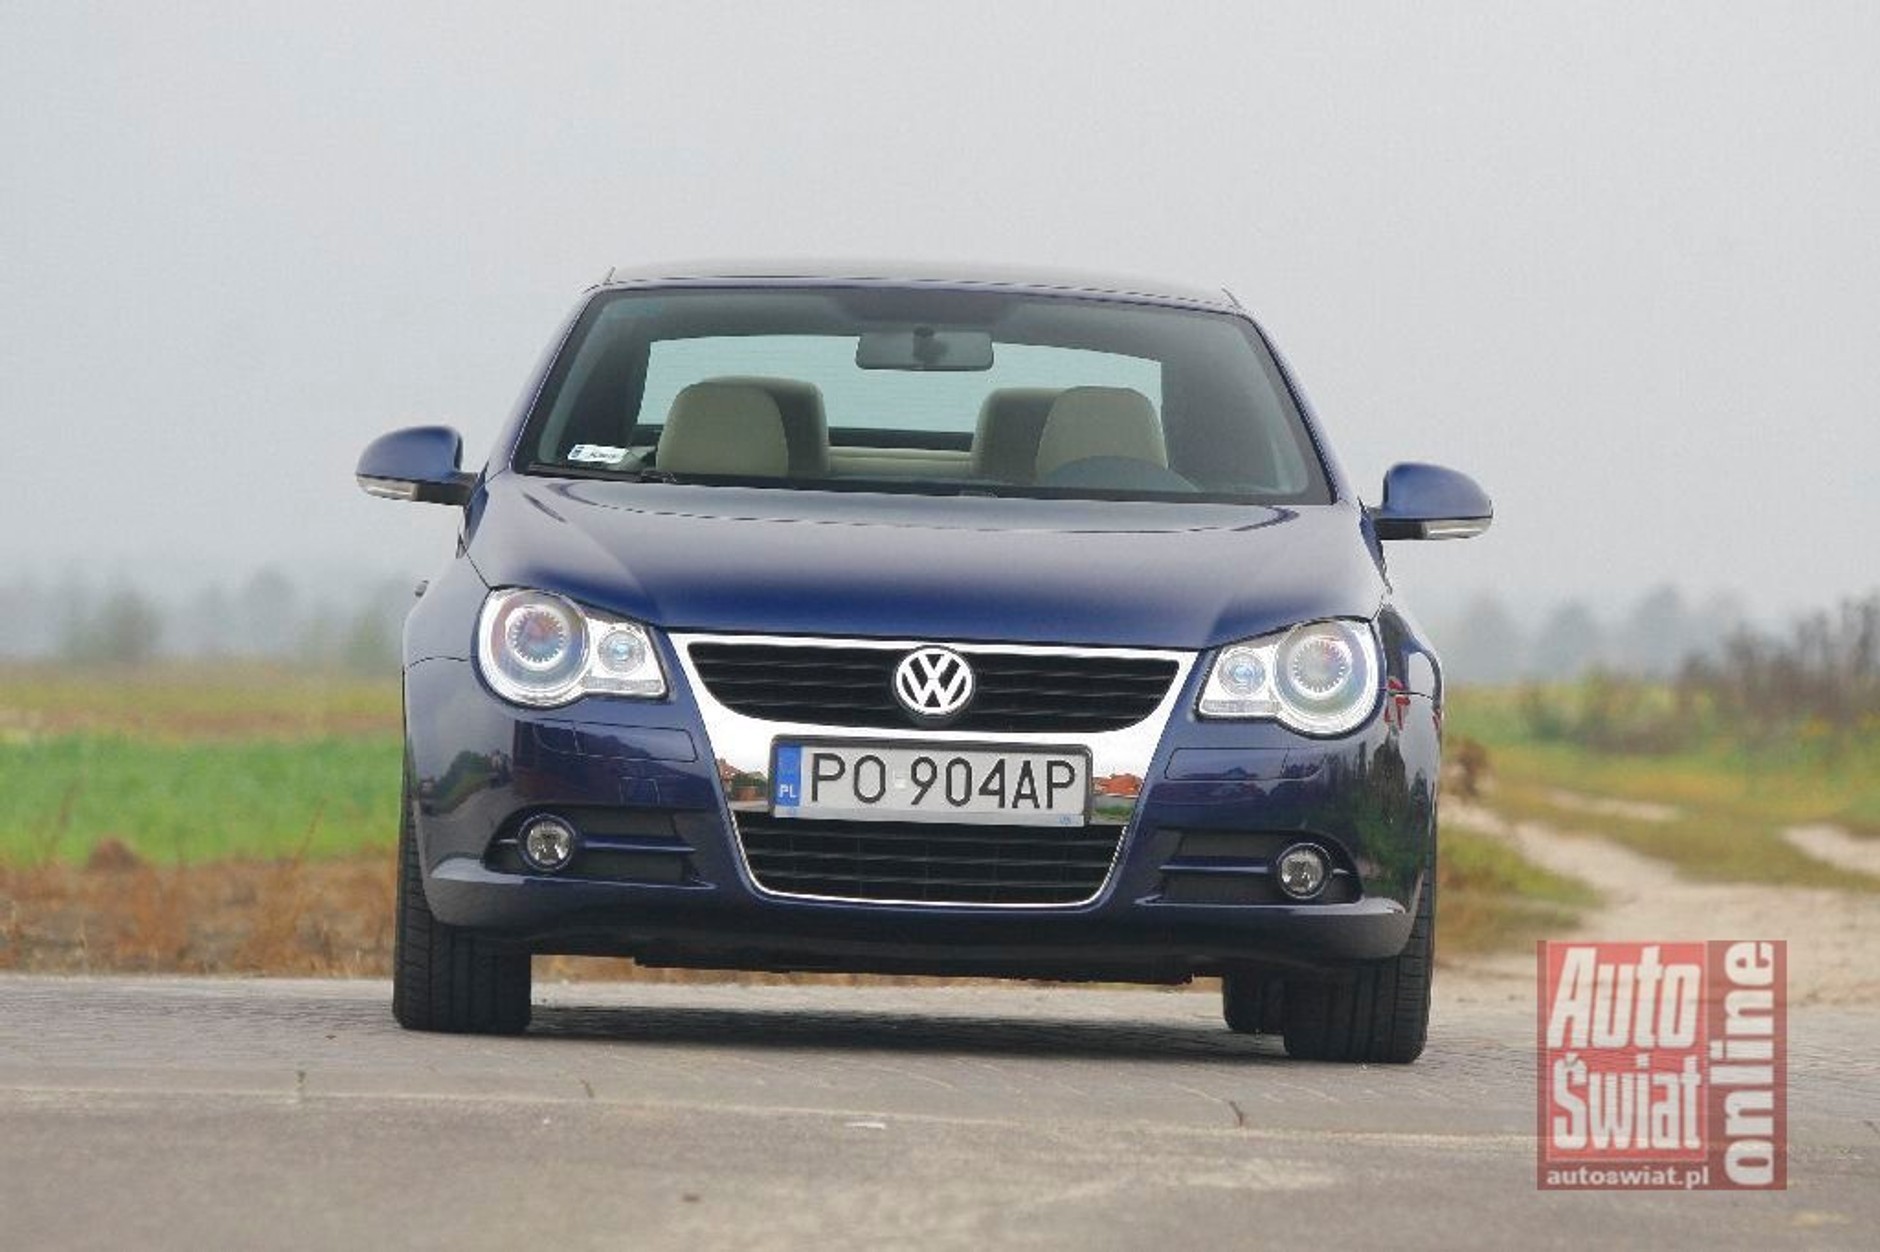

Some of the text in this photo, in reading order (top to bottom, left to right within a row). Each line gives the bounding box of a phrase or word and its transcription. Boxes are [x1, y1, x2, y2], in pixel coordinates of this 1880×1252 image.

[897, 648, 972, 714] VW
[779, 784, 797, 799] PL
[811, 752, 1076, 809] PO 904AP
